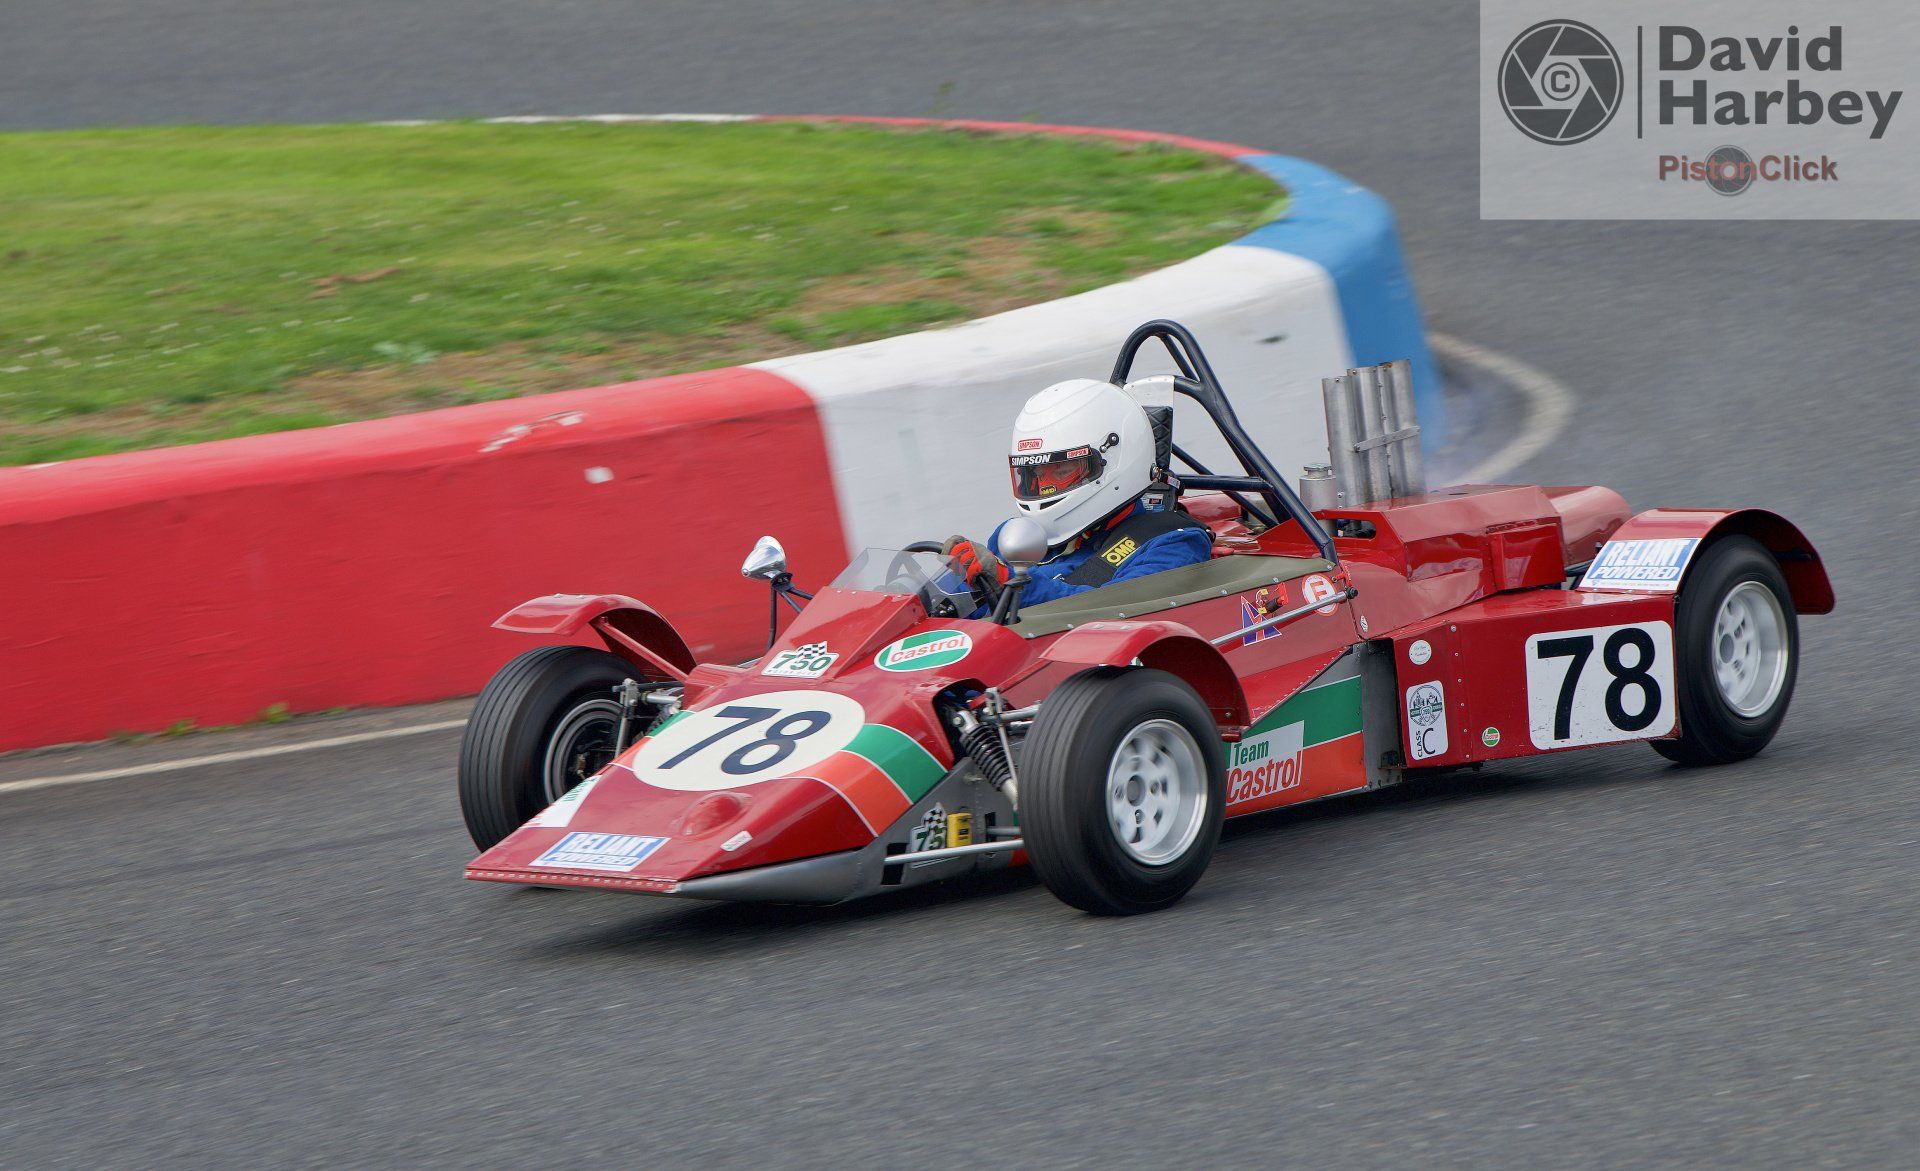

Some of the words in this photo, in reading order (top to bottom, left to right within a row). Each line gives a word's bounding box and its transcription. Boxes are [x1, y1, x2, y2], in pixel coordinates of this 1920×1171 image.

[1018, 440, 1041, 450] SIMPSON
[1011, 454, 1051, 466] SIMPSON
[1106, 539, 1136, 563] OMP
[1601, 539, 1692, 567] RELIANT
[1589, 566, 1681, 580] POWERED
[772, 653, 832, 672] 750
[889, 636, 967, 664] Castrol
[1536, 627, 1662, 741] 78
[656, 705, 832, 775] 78
[1233, 740, 1270, 767] Team
[1415, 730, 1423, 758] CLASS
[1422, 727, 1436, 755] C
[1226, 750, 1302, 804] Castrol
[559, 832, 660, 857] RELIANT
